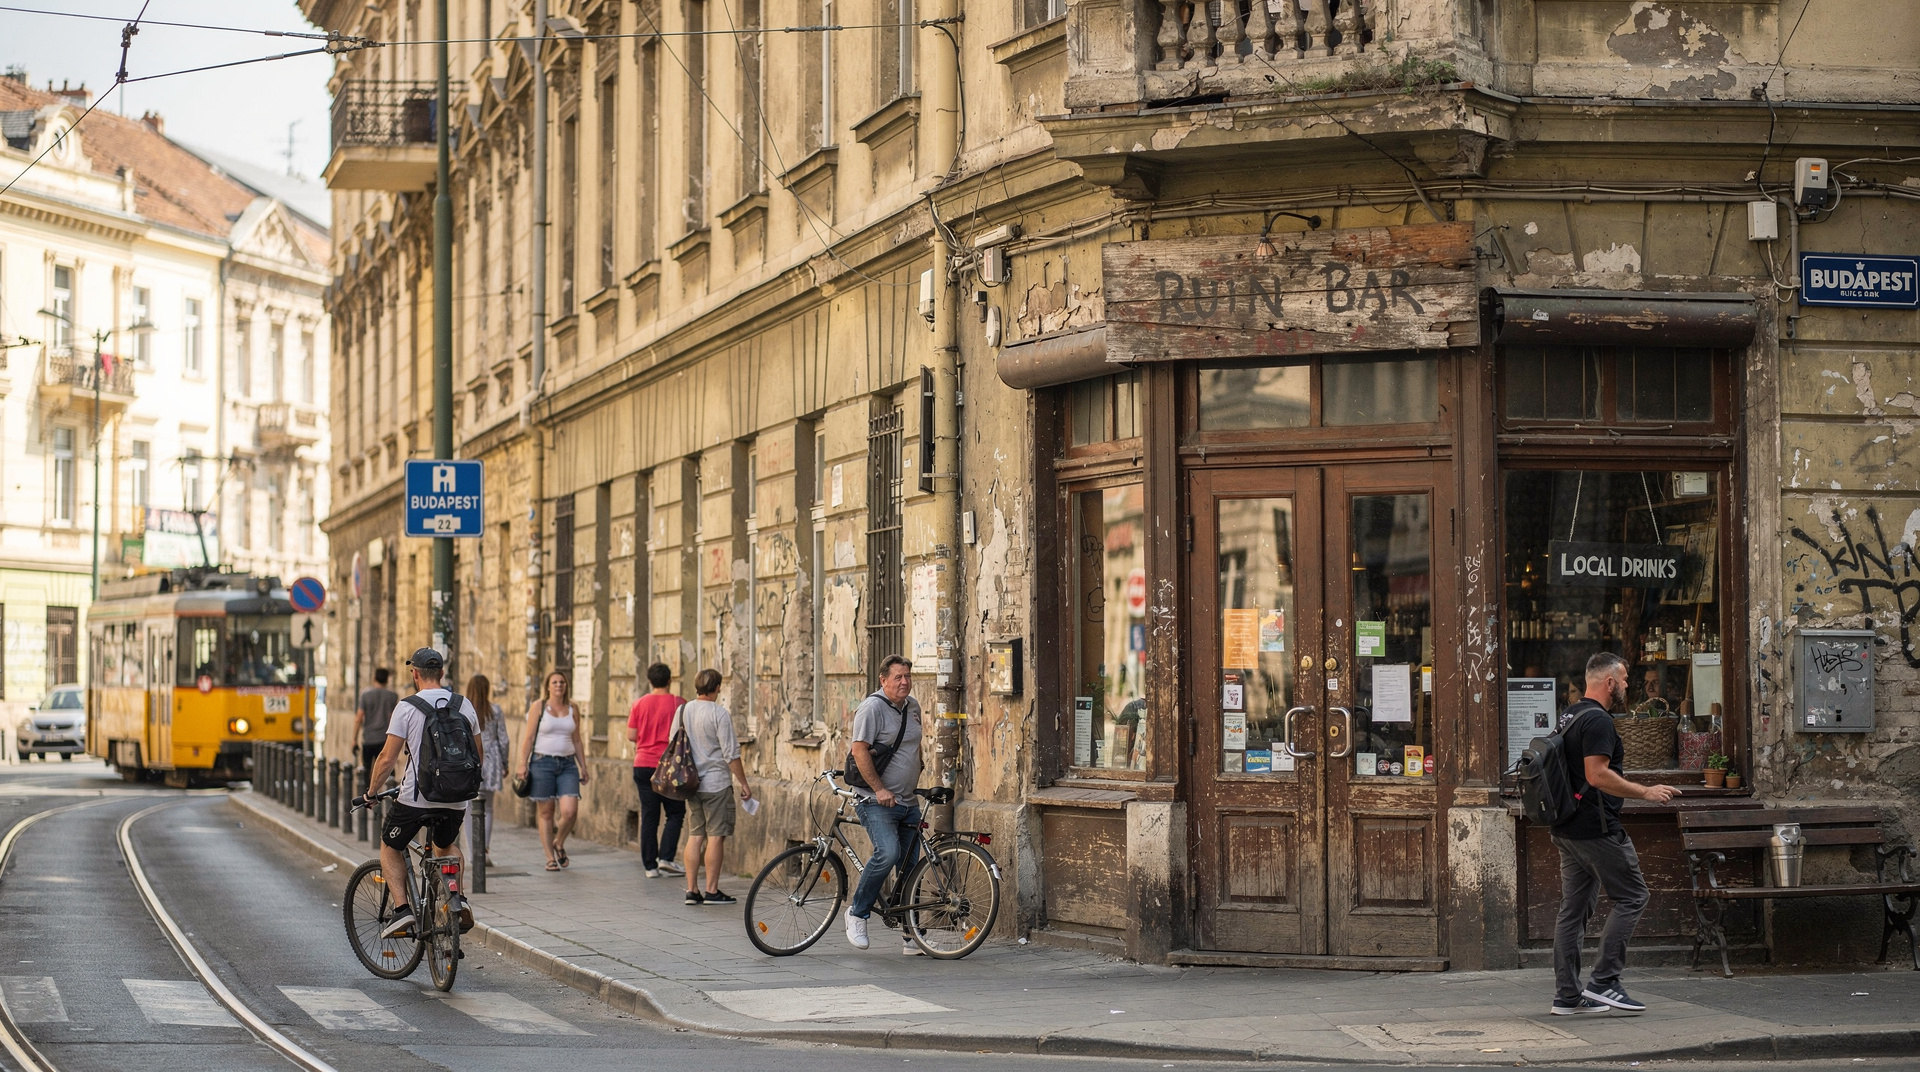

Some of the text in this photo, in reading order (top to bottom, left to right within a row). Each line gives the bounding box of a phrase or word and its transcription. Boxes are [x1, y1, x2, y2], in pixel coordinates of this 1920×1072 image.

[1154, 260, 1425, 322] RUIN BAR
[1810, 268, 1913, 291] BUDAPEST
[411, 495, 479, 510] BUDAPEST
[438, 519, 451, 530] 22
[1561, 553, 1677, 579] LOCAL DRINKS
